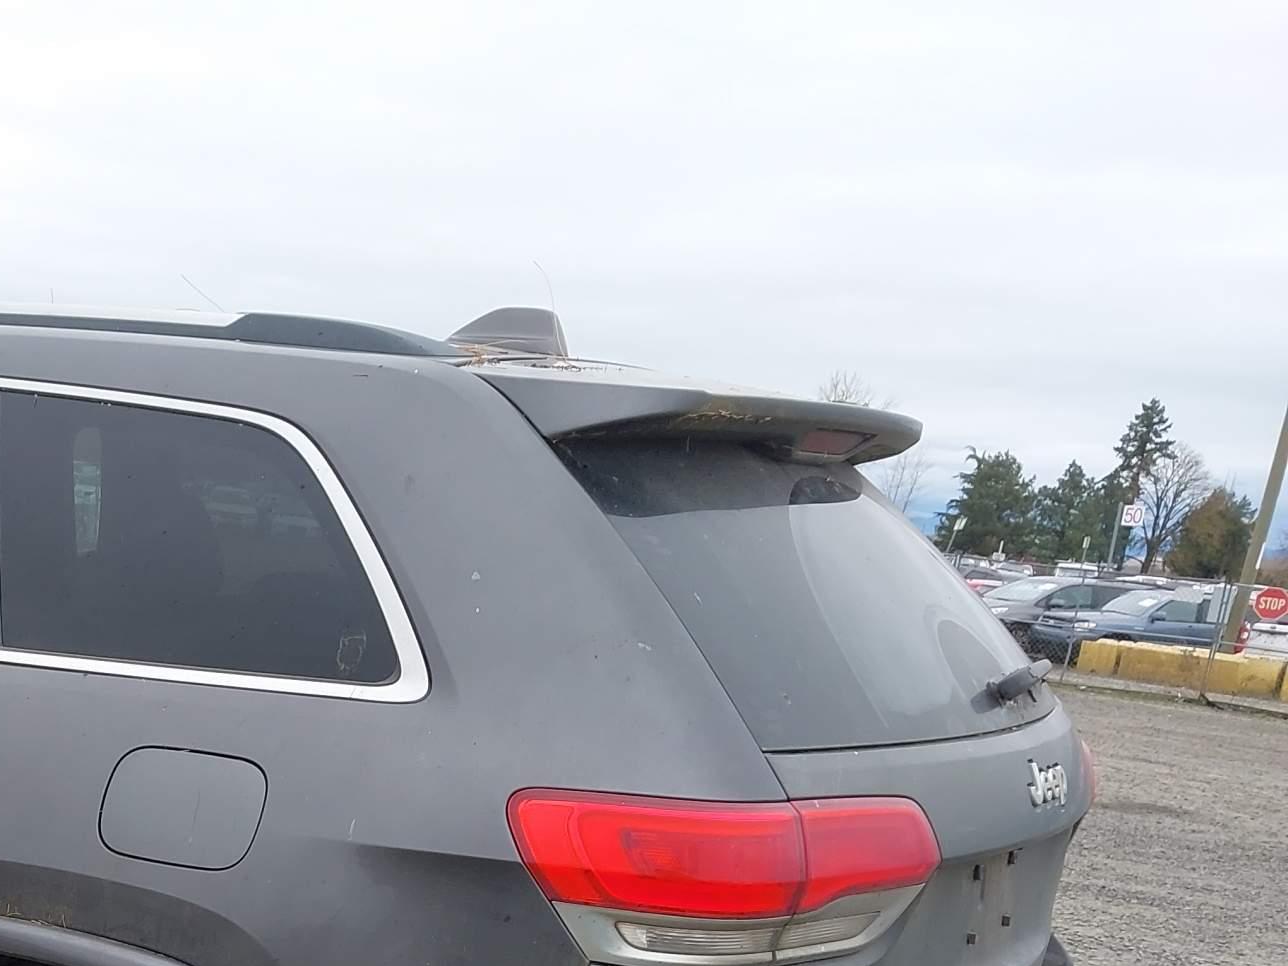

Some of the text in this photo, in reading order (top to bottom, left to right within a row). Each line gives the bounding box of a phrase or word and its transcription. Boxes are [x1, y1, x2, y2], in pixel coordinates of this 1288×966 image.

[1123, 507, 1143, 524] 50
[1258, 596, 1286, 611] STOP
[1027, 759, 1068, 807] Jeep
